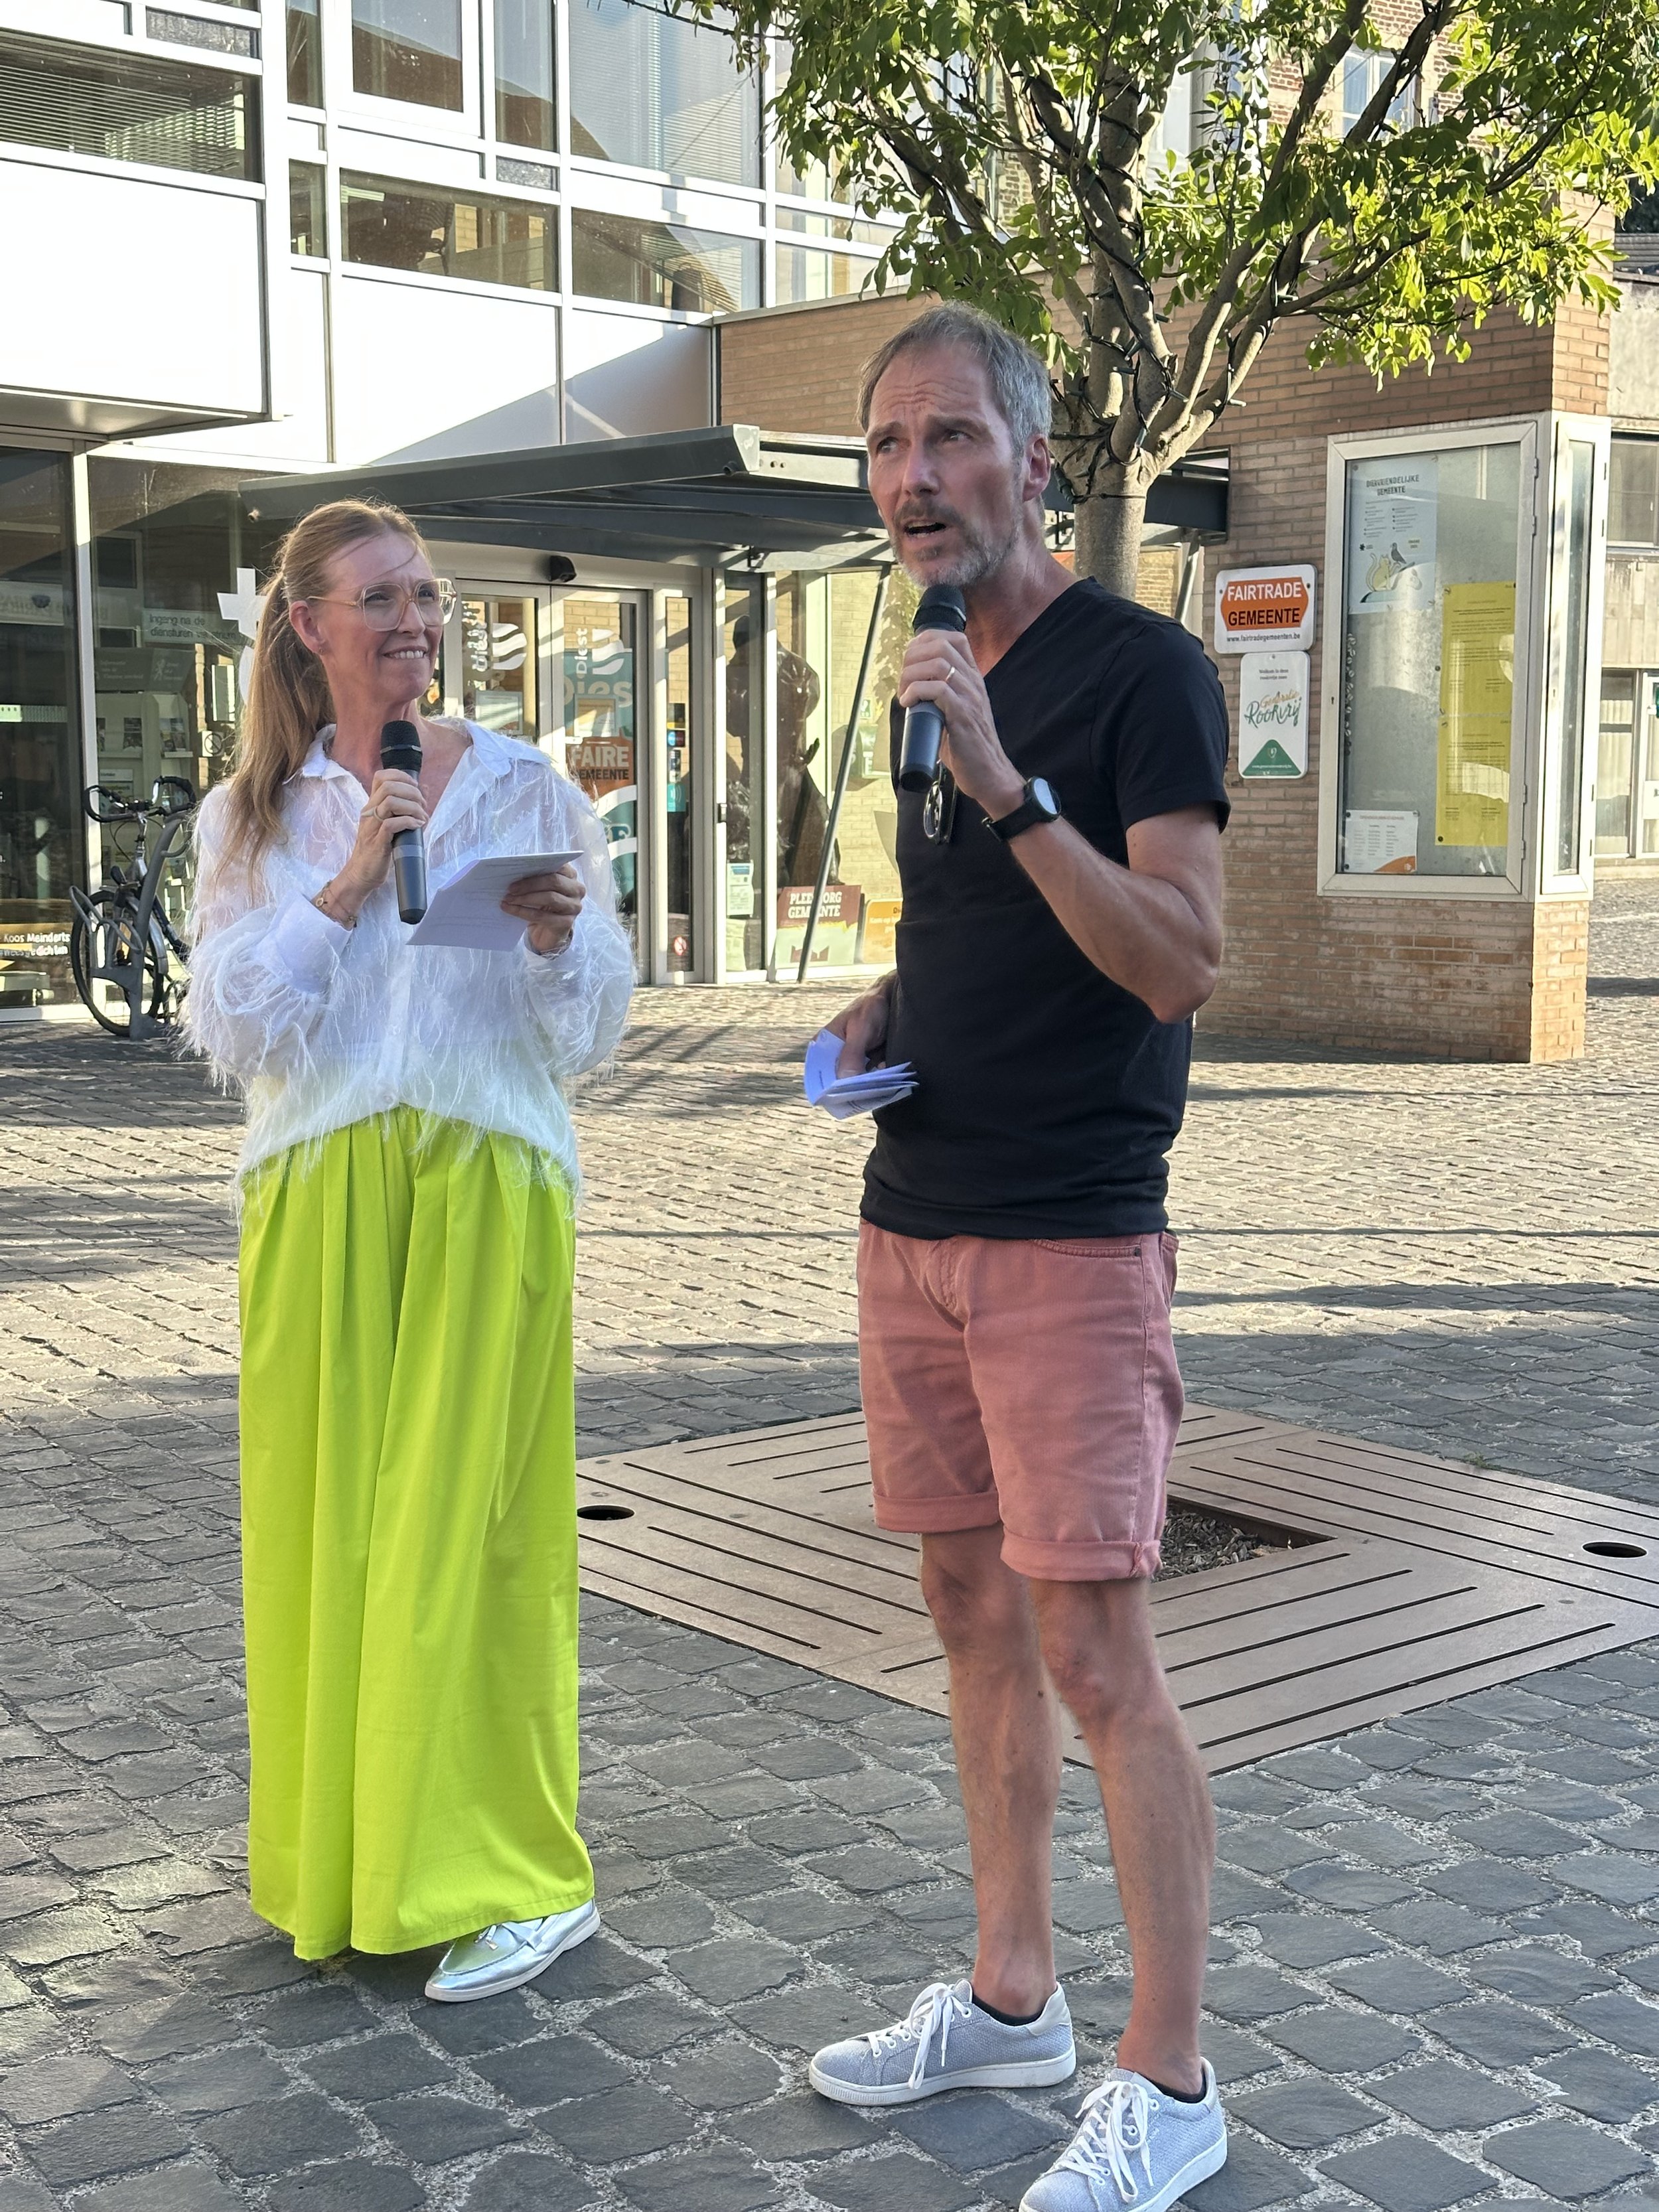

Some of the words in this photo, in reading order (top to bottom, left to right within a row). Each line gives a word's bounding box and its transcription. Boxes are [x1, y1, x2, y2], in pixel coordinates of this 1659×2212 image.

[1377, 485, 1406, 496] GEMEENTE
[1227, 581, 1302, 601] FAIRTRADE
[149, 613, 179, 626] Ingang
[180, 617, 191, 625] na
[194, 616, 206, 625] de
[1228, 607, 1300, 626] GEMEENTE
[1226, 632, 1301, 642] www.fairtradegemeenten.be
[571, 745, 630, 767] FAIRE
[579, 769, 629, 780] EMEENTE
[789, 891, 842, 905] PLEEORG
[788, 905, 841, 919] GEMNTE
[4, 933, 25, 943] Koos
[27, 932, 70, 943] Meinderts
